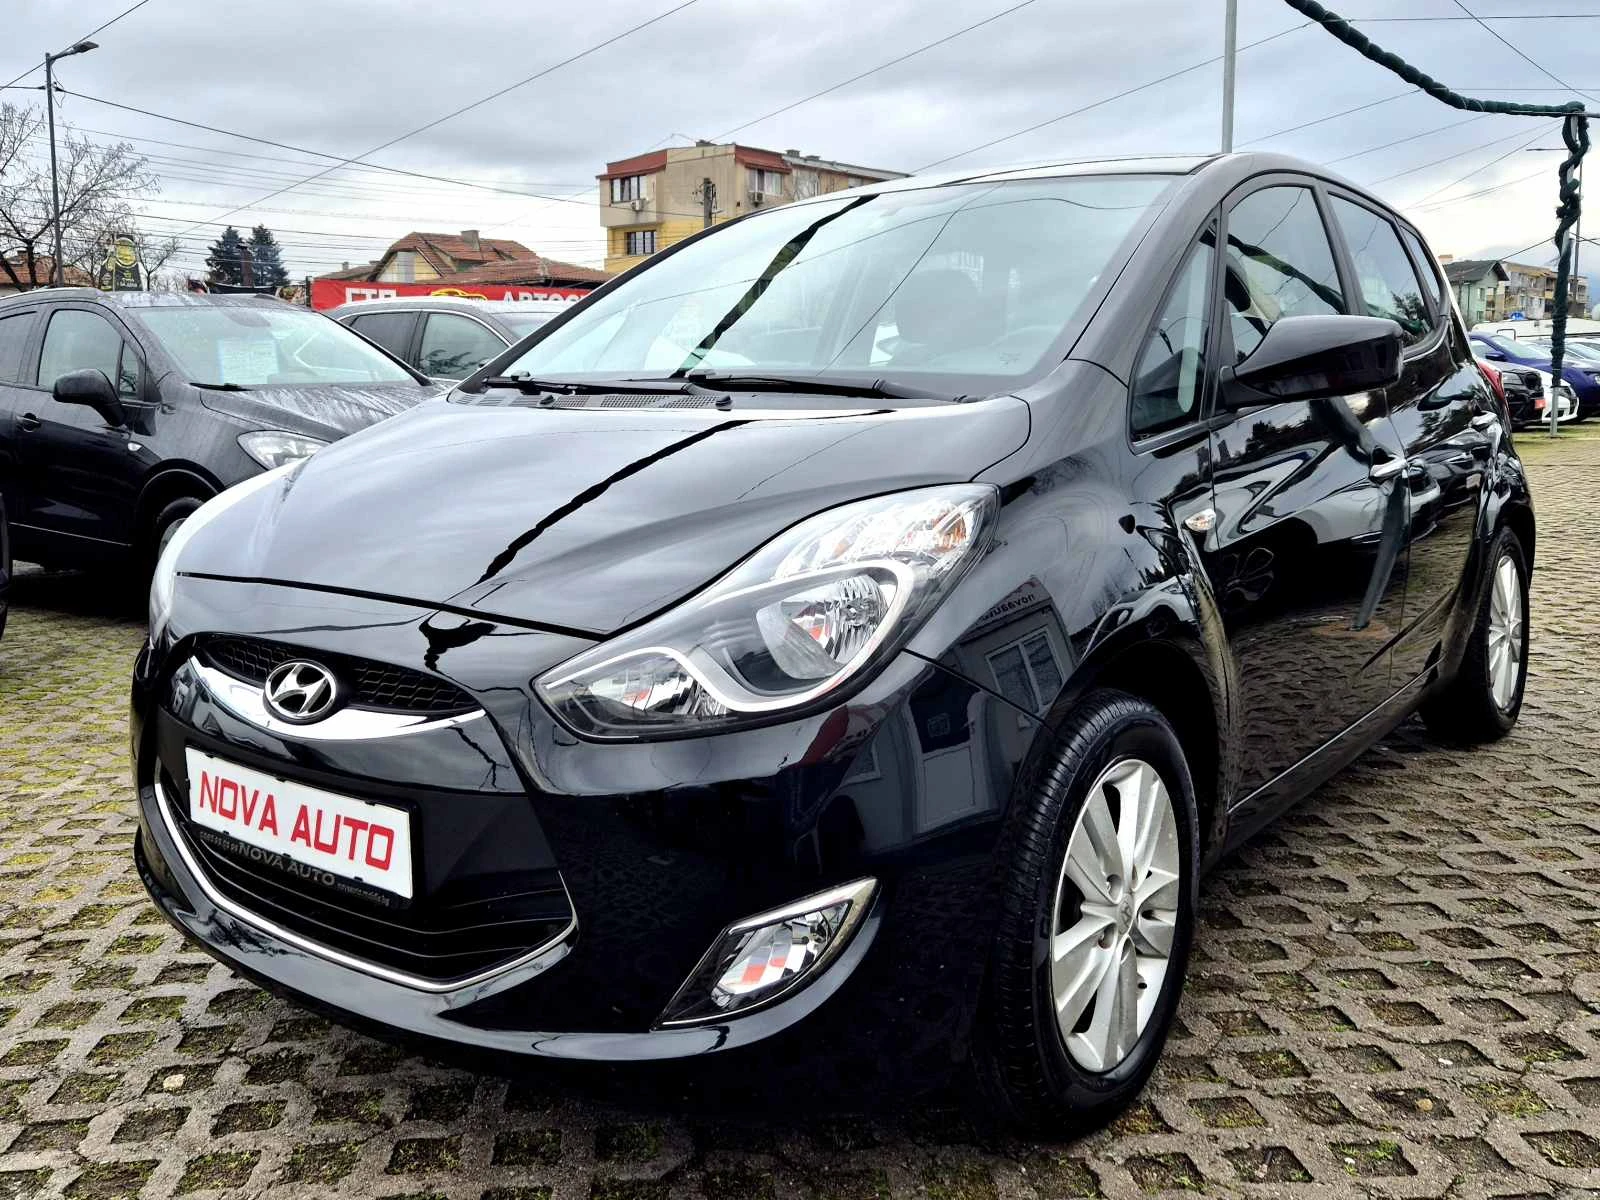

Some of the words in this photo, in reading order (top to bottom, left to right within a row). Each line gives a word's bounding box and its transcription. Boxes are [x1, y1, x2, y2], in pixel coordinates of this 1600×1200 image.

[503, 290, 586, 303] АВТОС
[200, 770, 278, 836] NOVA
[291, 804, 395, 871] AUTO
[239, 842, 284, 870] NOVA
[287, 861, 335, 886] AUTO
